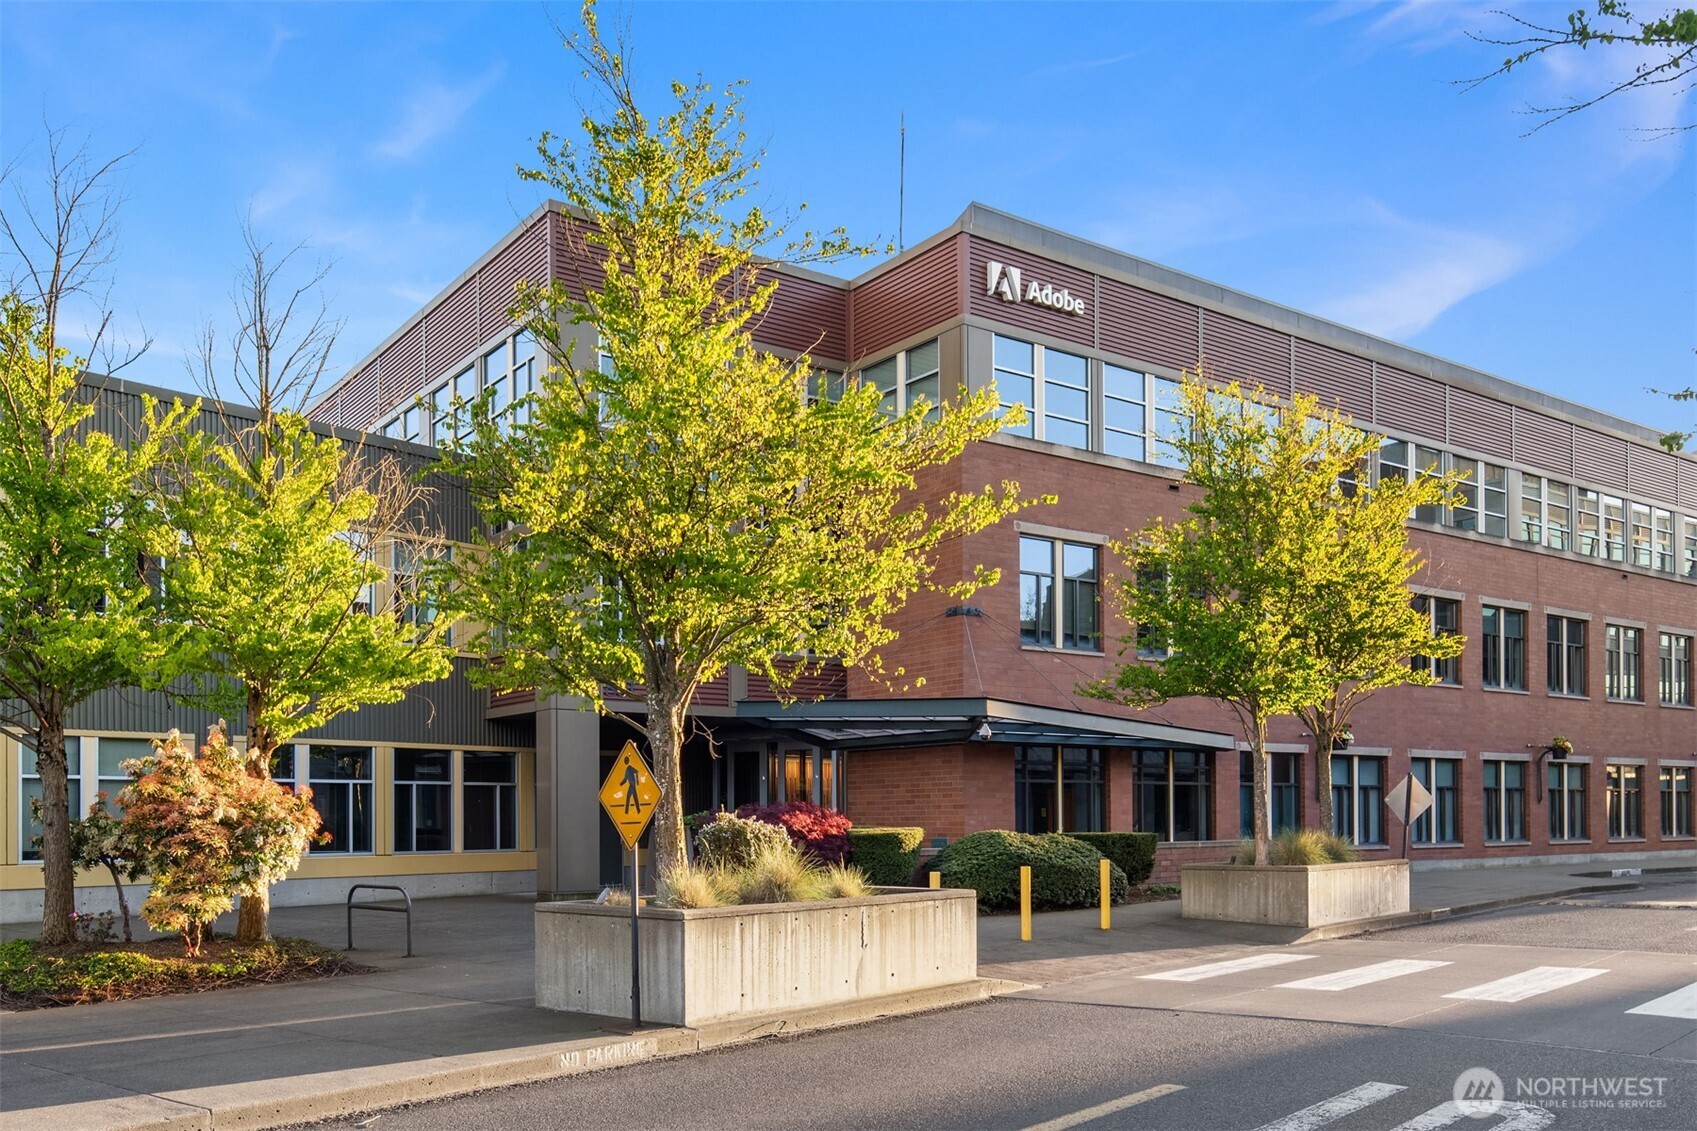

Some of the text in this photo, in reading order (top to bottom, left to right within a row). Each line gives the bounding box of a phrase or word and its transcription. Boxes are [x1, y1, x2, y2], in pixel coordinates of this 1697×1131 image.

[1025, 281, 1085, 315] Adobe
[560, 1041, 645, 1068] NO PARKING
